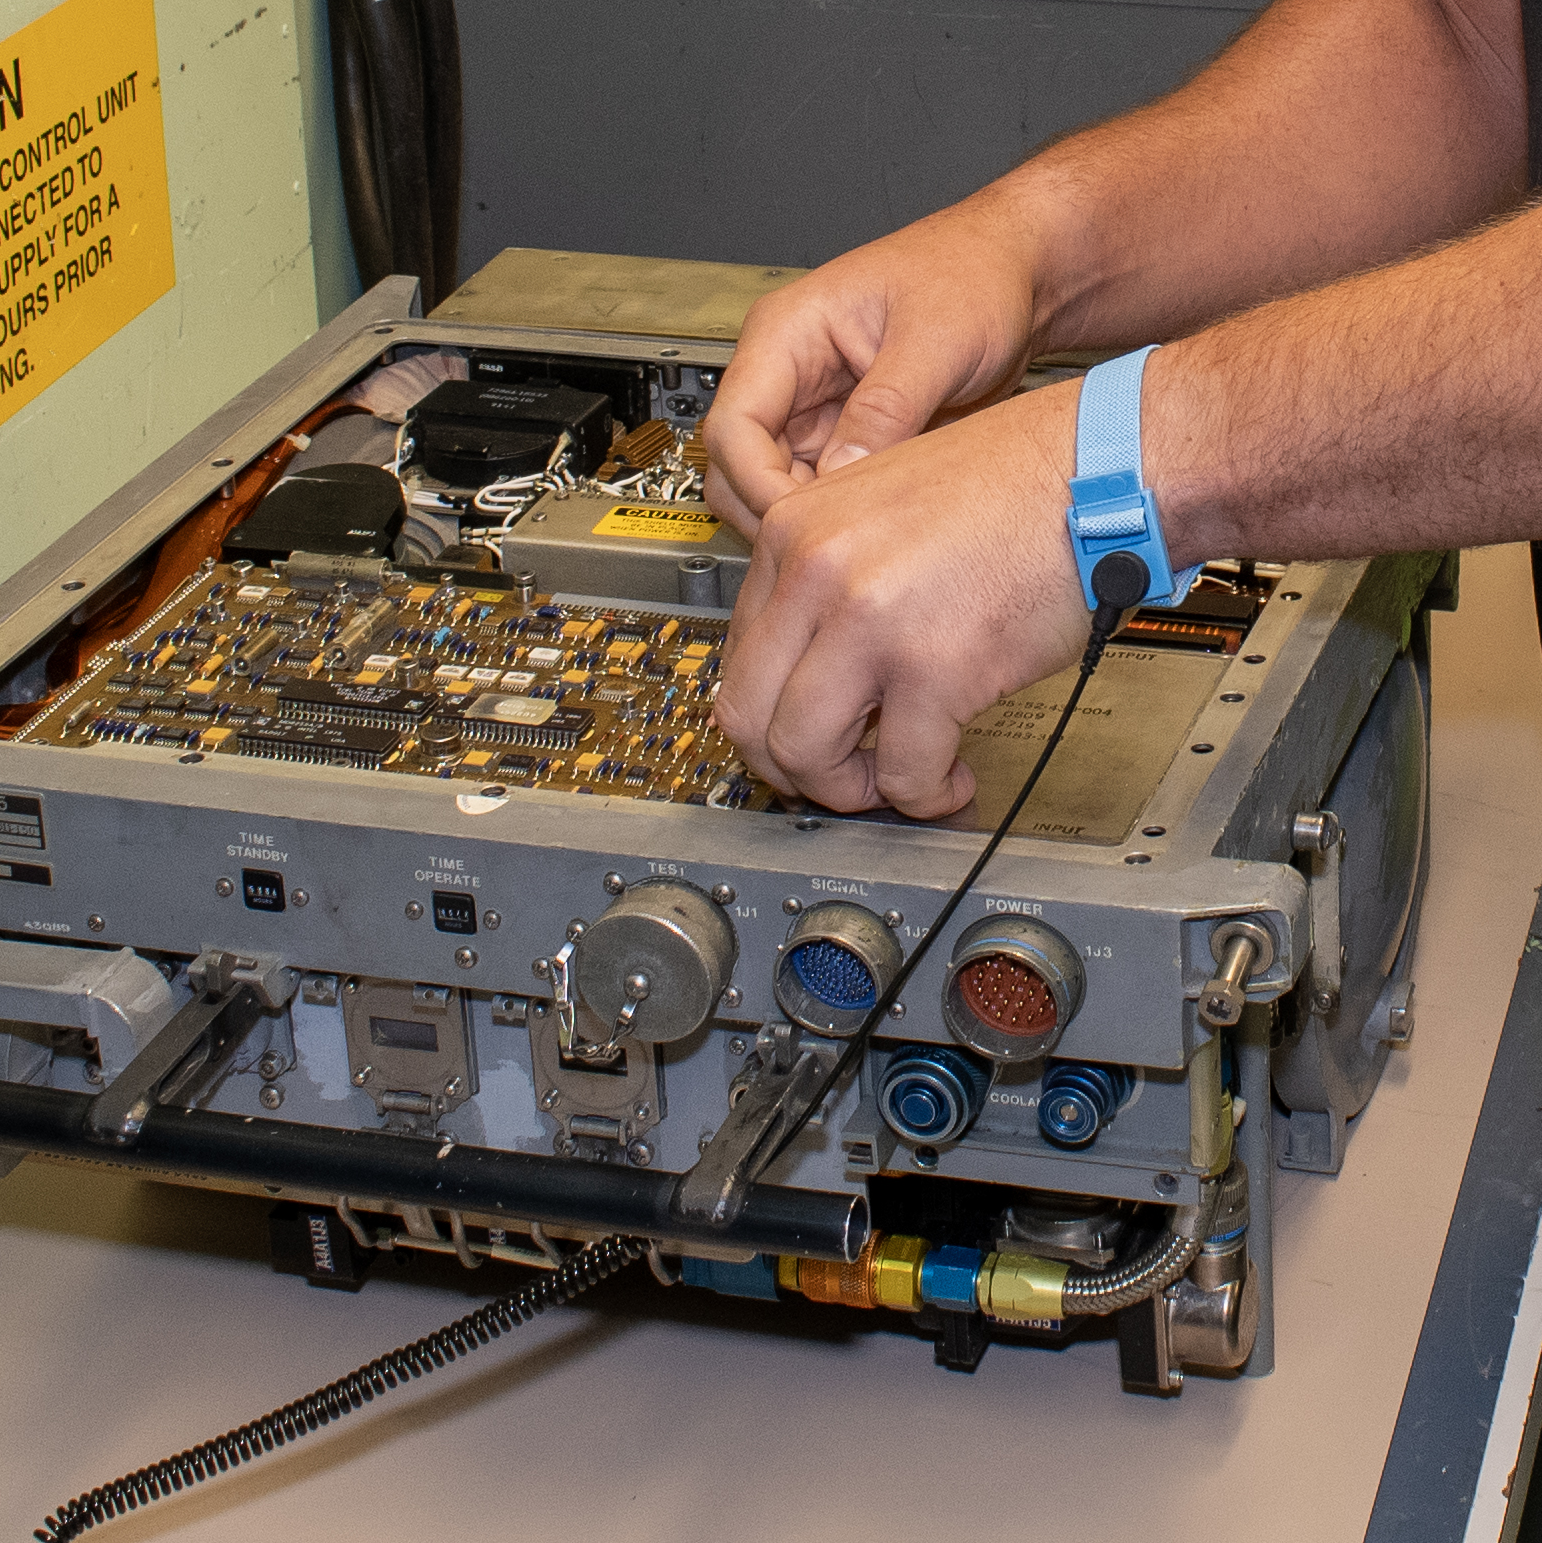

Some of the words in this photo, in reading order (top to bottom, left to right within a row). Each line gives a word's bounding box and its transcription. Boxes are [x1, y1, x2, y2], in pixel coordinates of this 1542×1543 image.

[96, 71, 139, 127] UNIT
[77, 145, 104, 196] TO
[62, 197, 105, 251] FOR
[107, 183, 121, 219] A
[53, 235, 113, 318] PRIOR
[626, 509, 711, 522] CAUTION
[1032, 823, 1086, 834] INPUT
[239, 832, 274, 847] TIME
[226, 845, 288, 863] STANDBY
[429, 856, 464, 871] TIME
[648, 862, 687, 876] TEST
[414, 869, 482, 888] OPERATE
[811, 877, 869, 896] SIGNAL
[735, 905, 758, 919] 1J1
[985, 899, 1043, 916] POWER
[1085, 945, 1112, 959] 1J3
[990, 1092, 1041, 1107] COOLA
